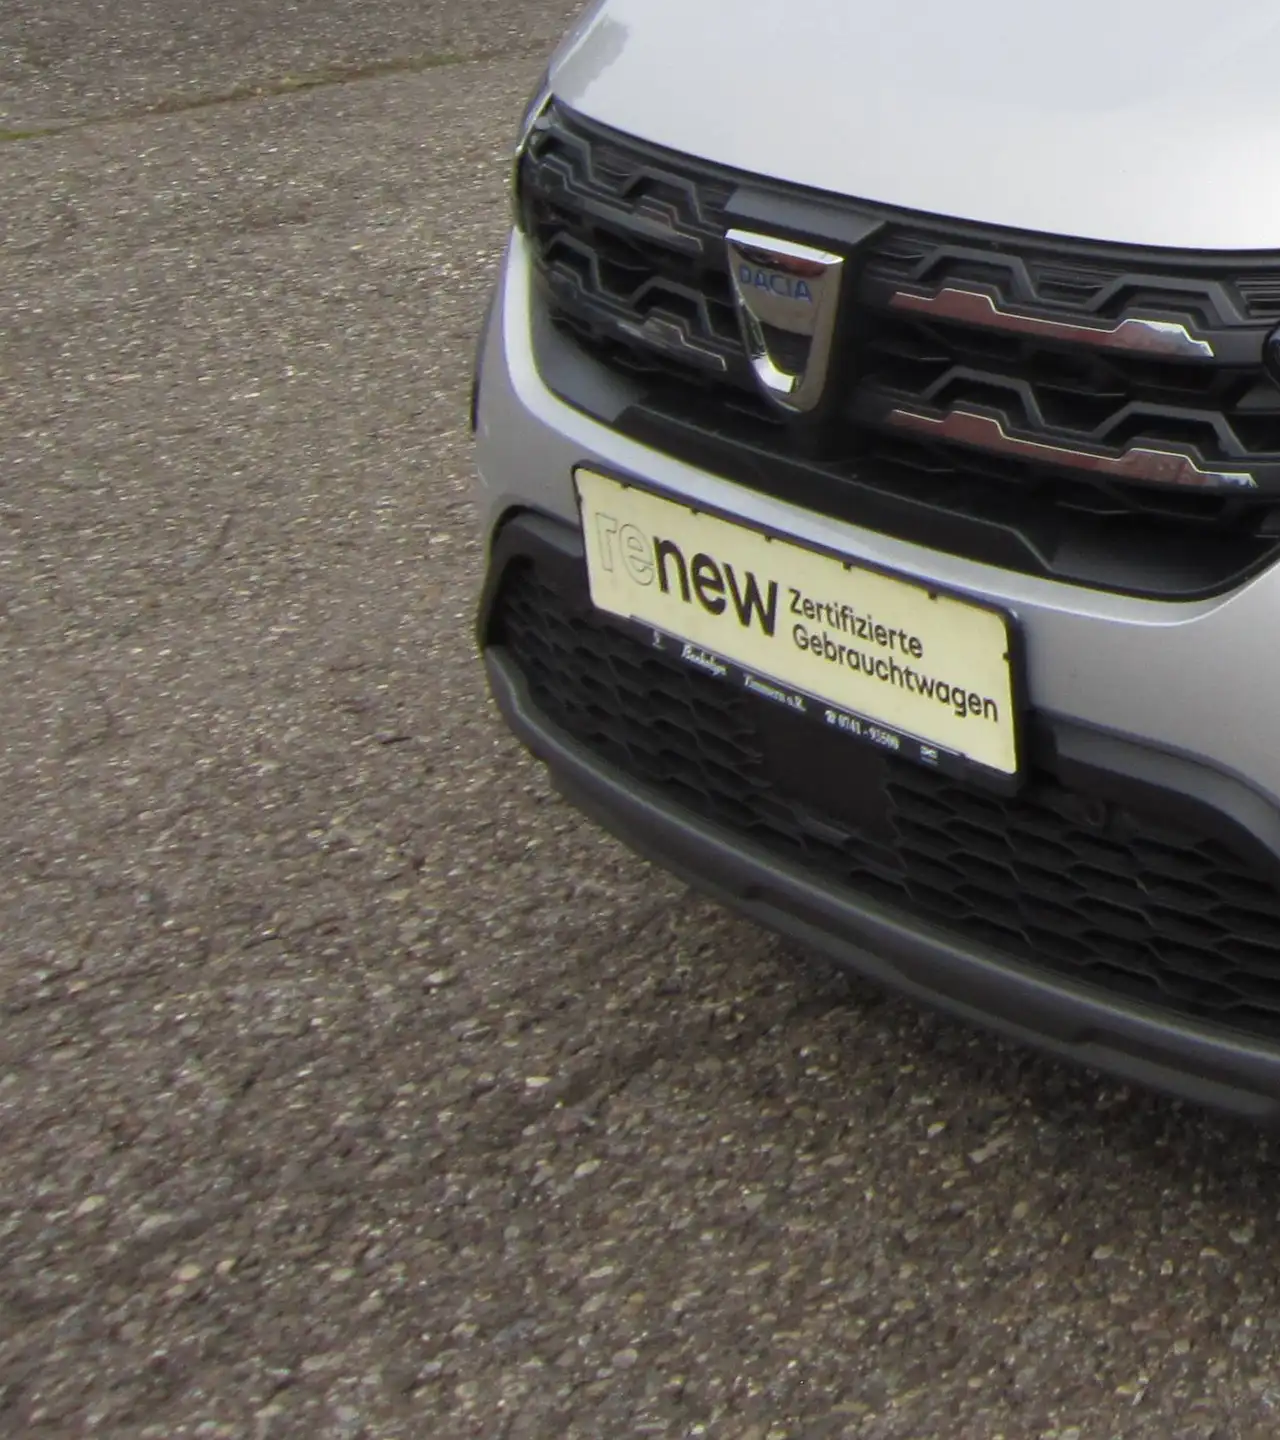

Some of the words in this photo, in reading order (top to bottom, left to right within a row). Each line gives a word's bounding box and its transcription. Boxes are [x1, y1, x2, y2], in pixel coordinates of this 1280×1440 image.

[739, 264, 813, 305] DACIA
[595, 511, 778, 638] renew
[789, 587, 924, 659] Zertifizierte
[792, 623, 998, 723] Gebrauchtwagen
